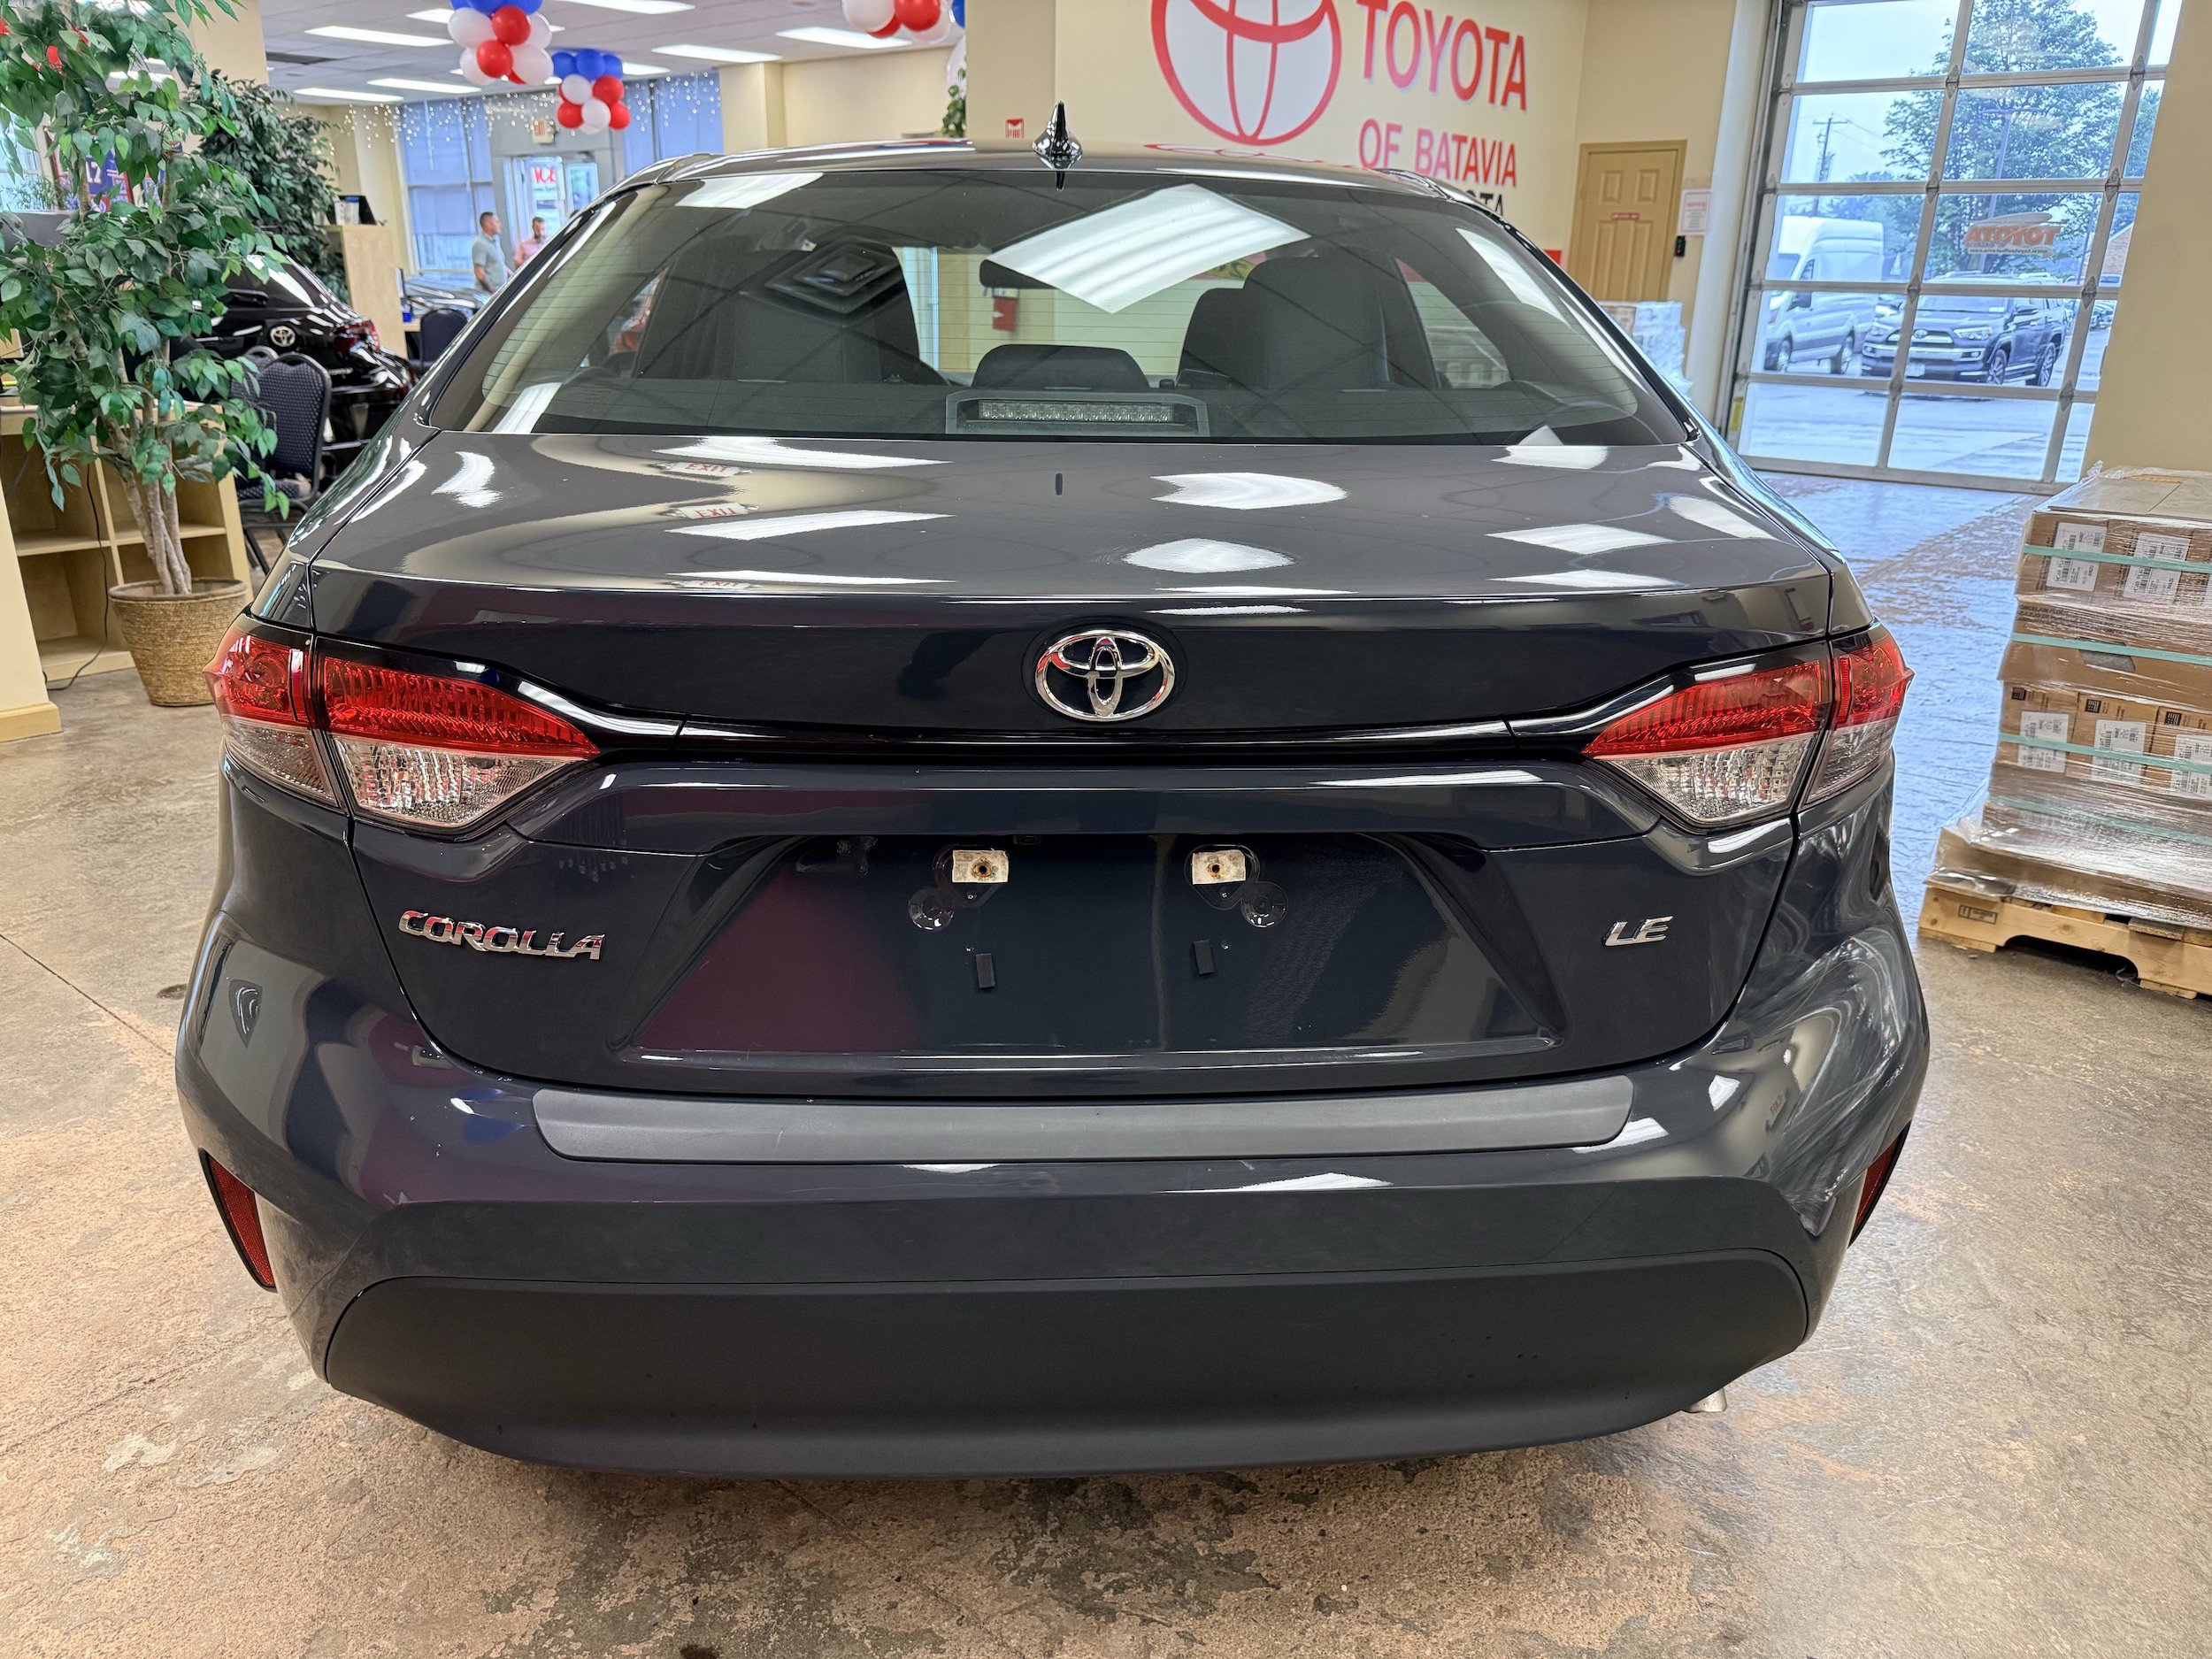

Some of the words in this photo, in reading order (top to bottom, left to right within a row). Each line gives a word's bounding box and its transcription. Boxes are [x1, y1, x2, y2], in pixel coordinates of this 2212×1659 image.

[1356, 0, 1527, 111] TOYOTA
[1358, 118, 1402, 170] OF
[1415, 127, 1517, 188] BATAVIA
[397, 910, 605, 960] COROLLA
[1602, 915, 1673, 947] LE
